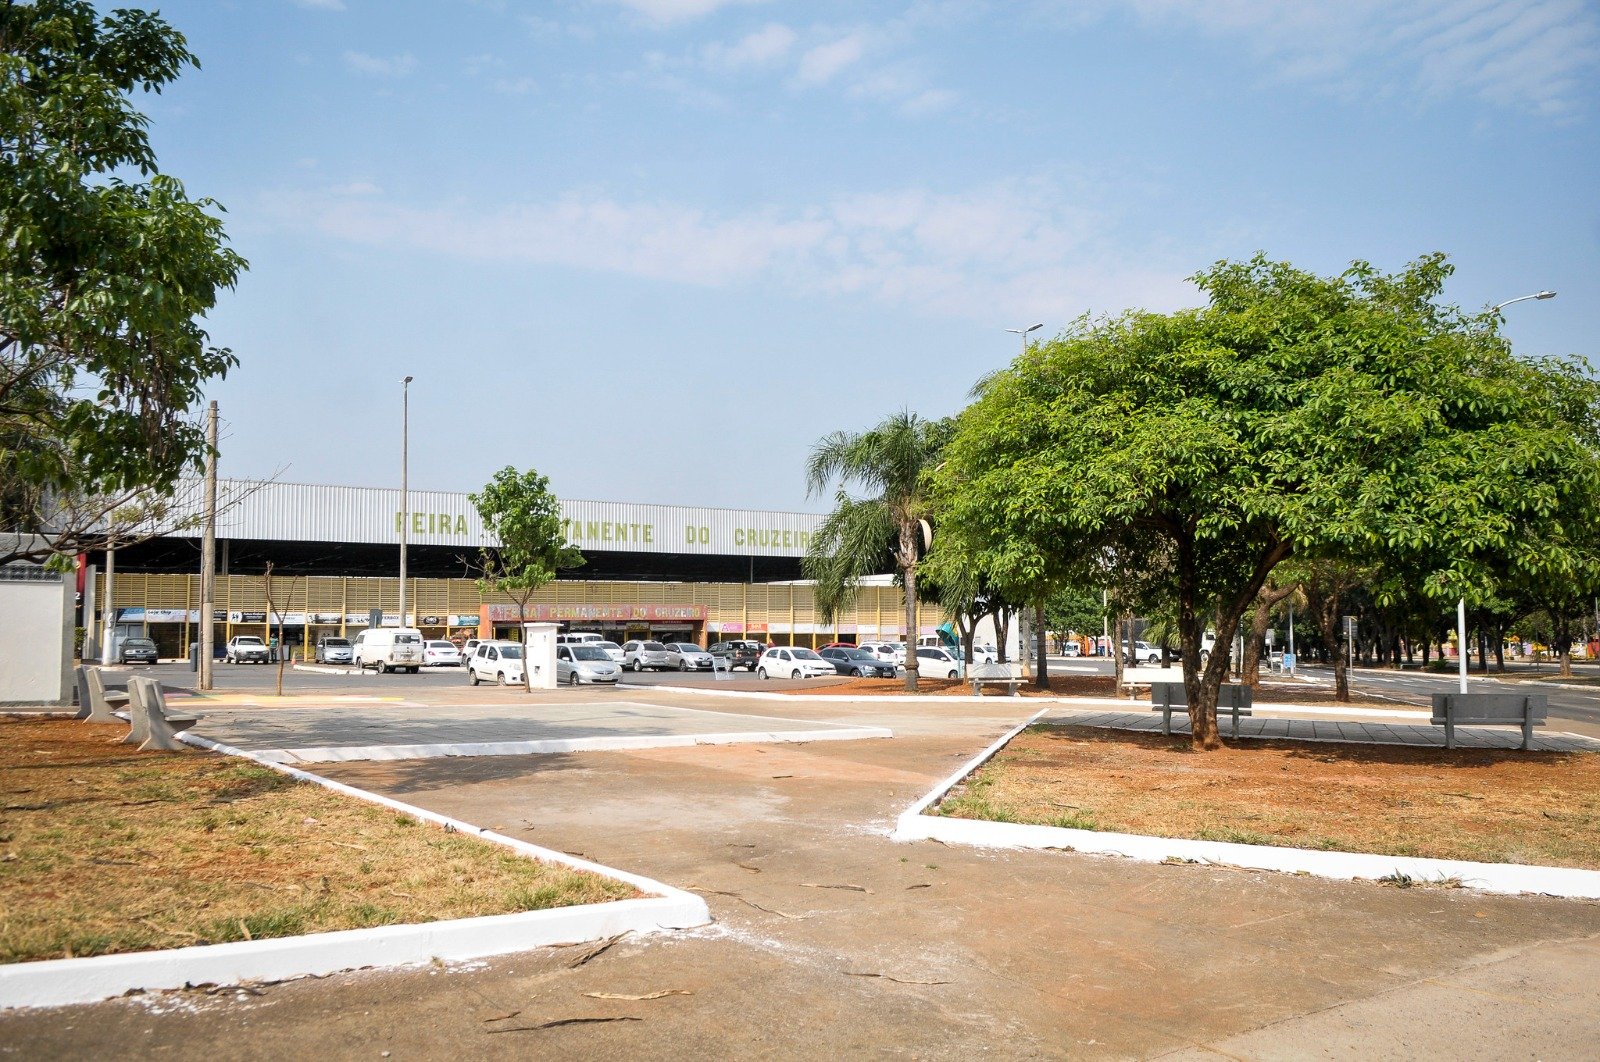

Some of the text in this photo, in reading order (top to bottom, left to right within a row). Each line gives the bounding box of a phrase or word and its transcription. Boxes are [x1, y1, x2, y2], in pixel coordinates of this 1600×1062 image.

[560, 520, 653, 543] ANENTE
[685, 525, 710, 545] DO
[734, 528, 810, 548] CRUZEIR
[505, 607, 700, 618] FERA PERMANENTE DO CRUZEIRO
